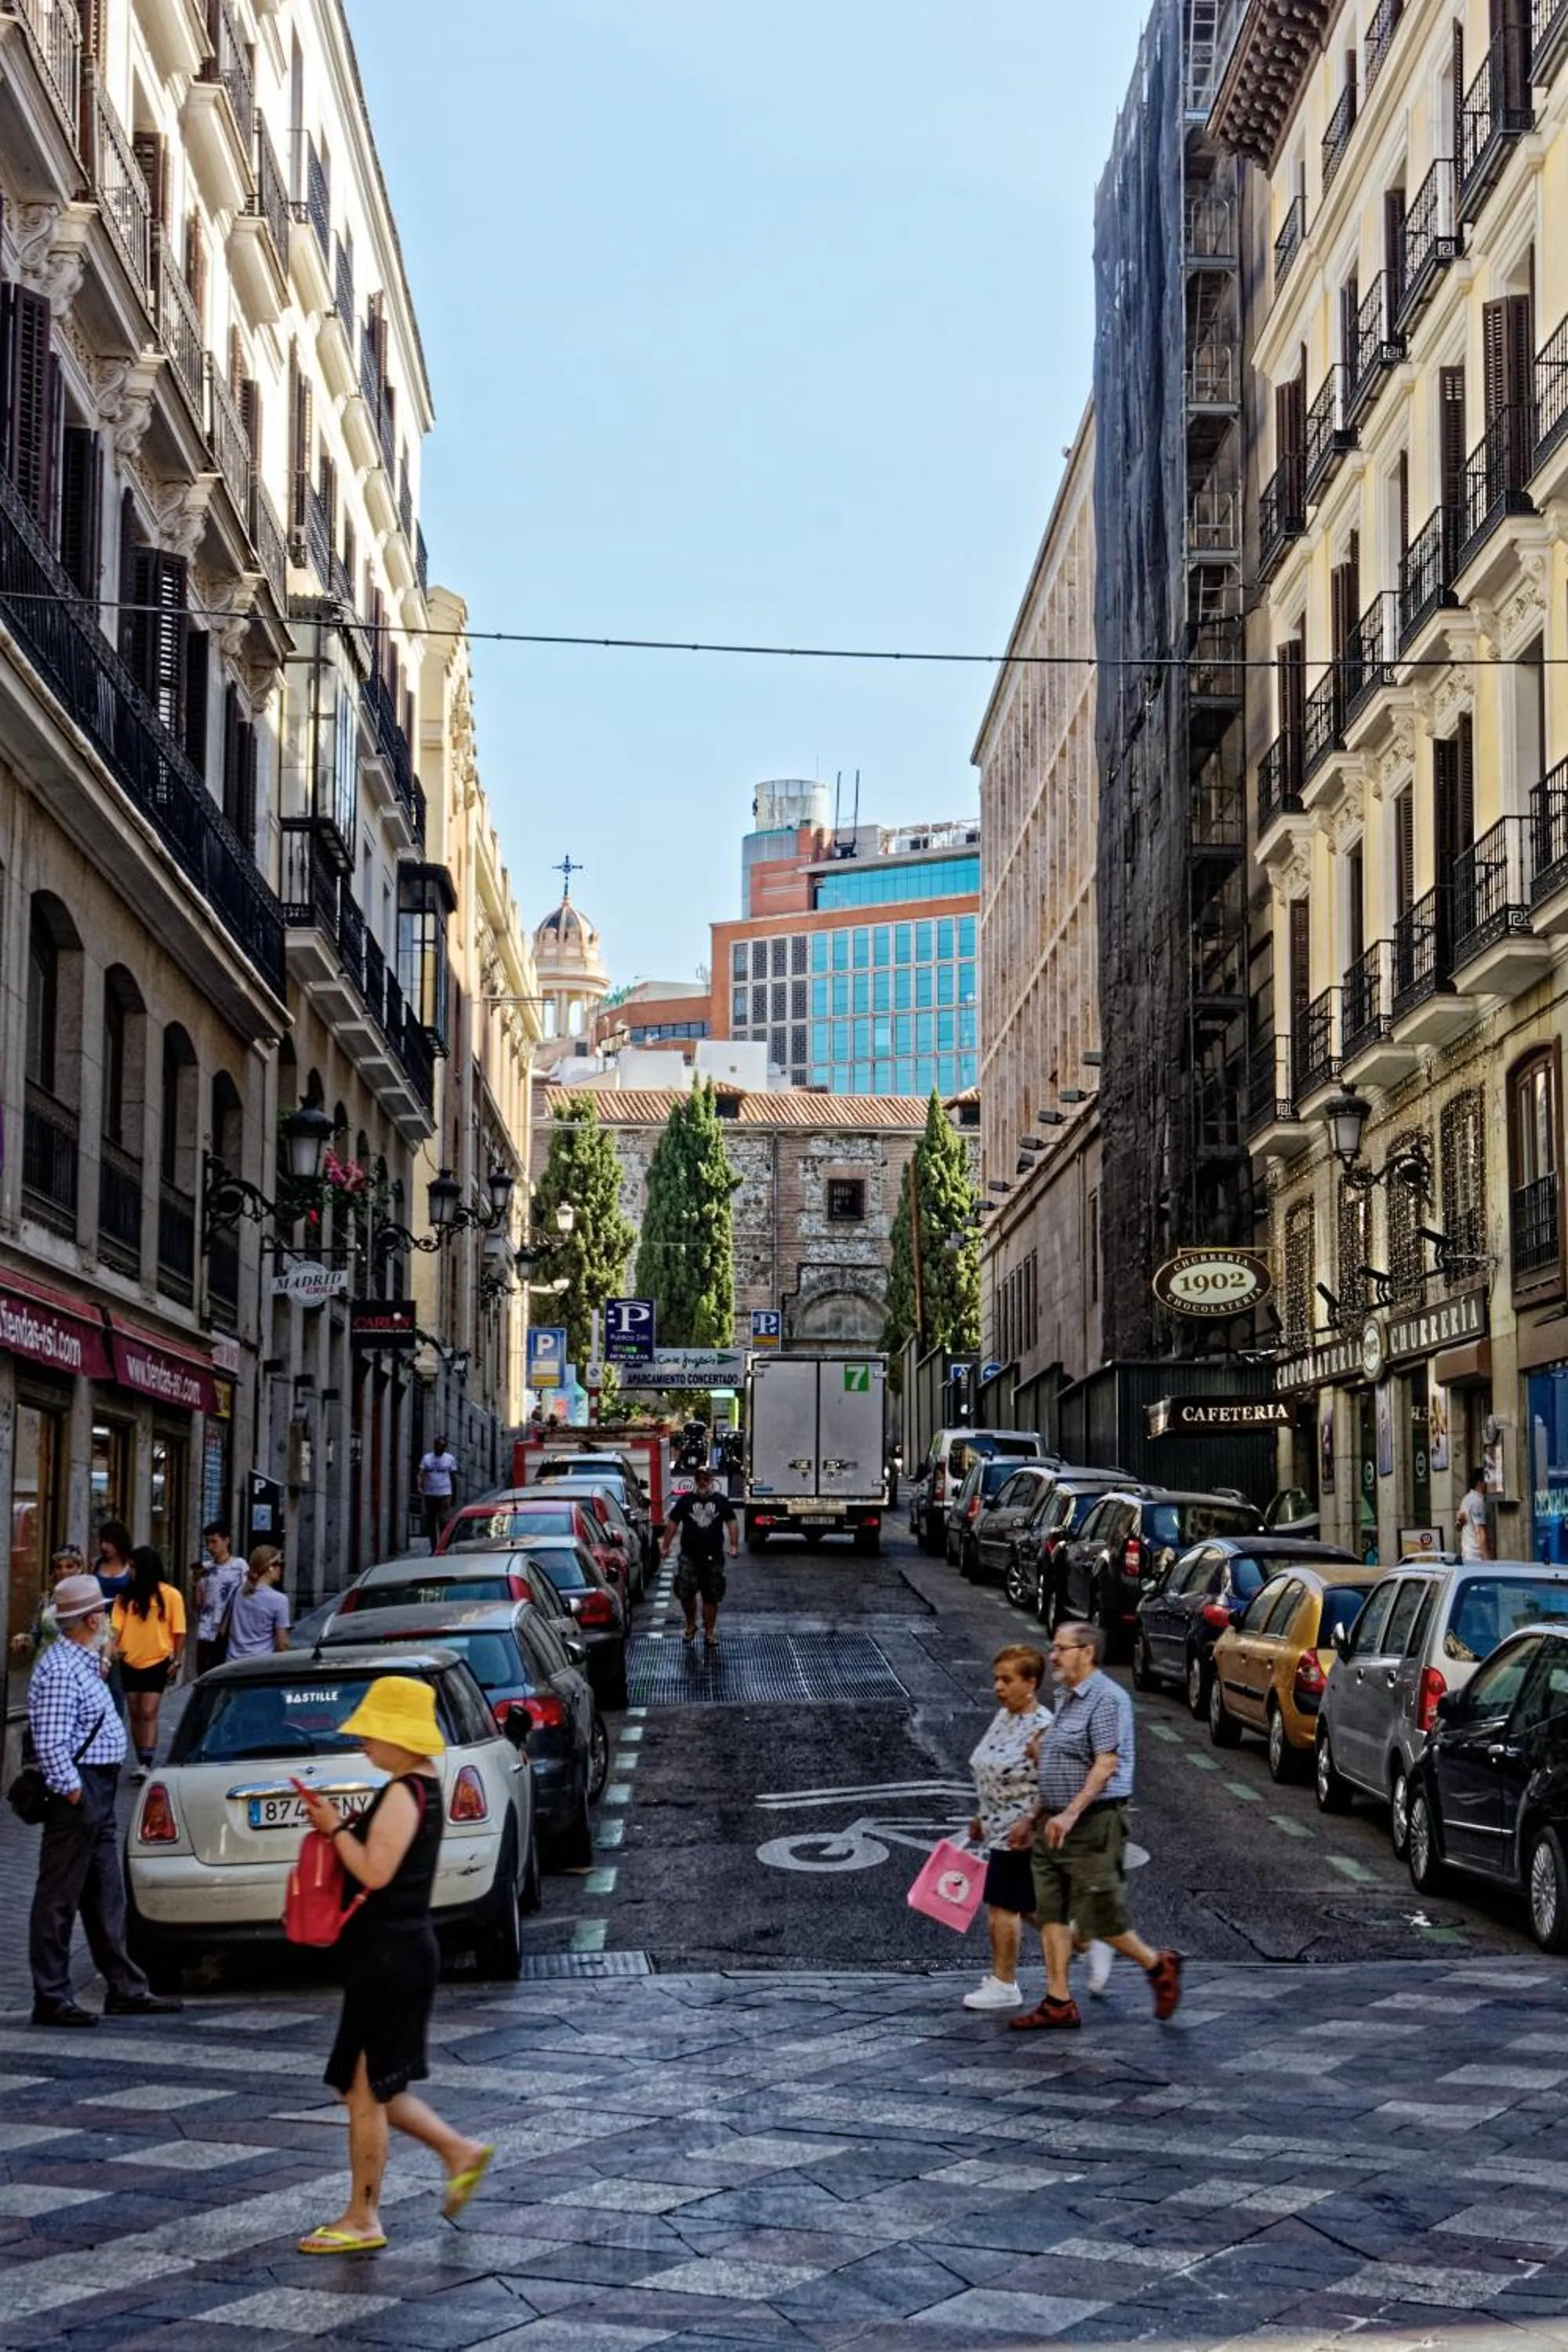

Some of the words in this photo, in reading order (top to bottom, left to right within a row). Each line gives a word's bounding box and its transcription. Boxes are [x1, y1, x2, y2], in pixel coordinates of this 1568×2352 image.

[276, 1272, 342, 1290] MADRID
[1179, 1272, 1246, 1295] 1902
[1390, 1296, 1478, 1354] CHURRERÍA
[537, 1334, 554, 1356] P
[1276, 1337, 1362, 1390] CHOCOLATERÍA
[627, 1373, 685, 1385] APARCAMIENTO
[688, 1373, 739, 1385] CONCERTADO
[847, 1366, 866, 1390] 7
[1181, 1403, 1290, 1421] CAFETERIA
[254, 1479, 266, 1494] P
[286, 1691, 339, 1704] BASTILLE
[265, 1800, 306, 1821] 874
